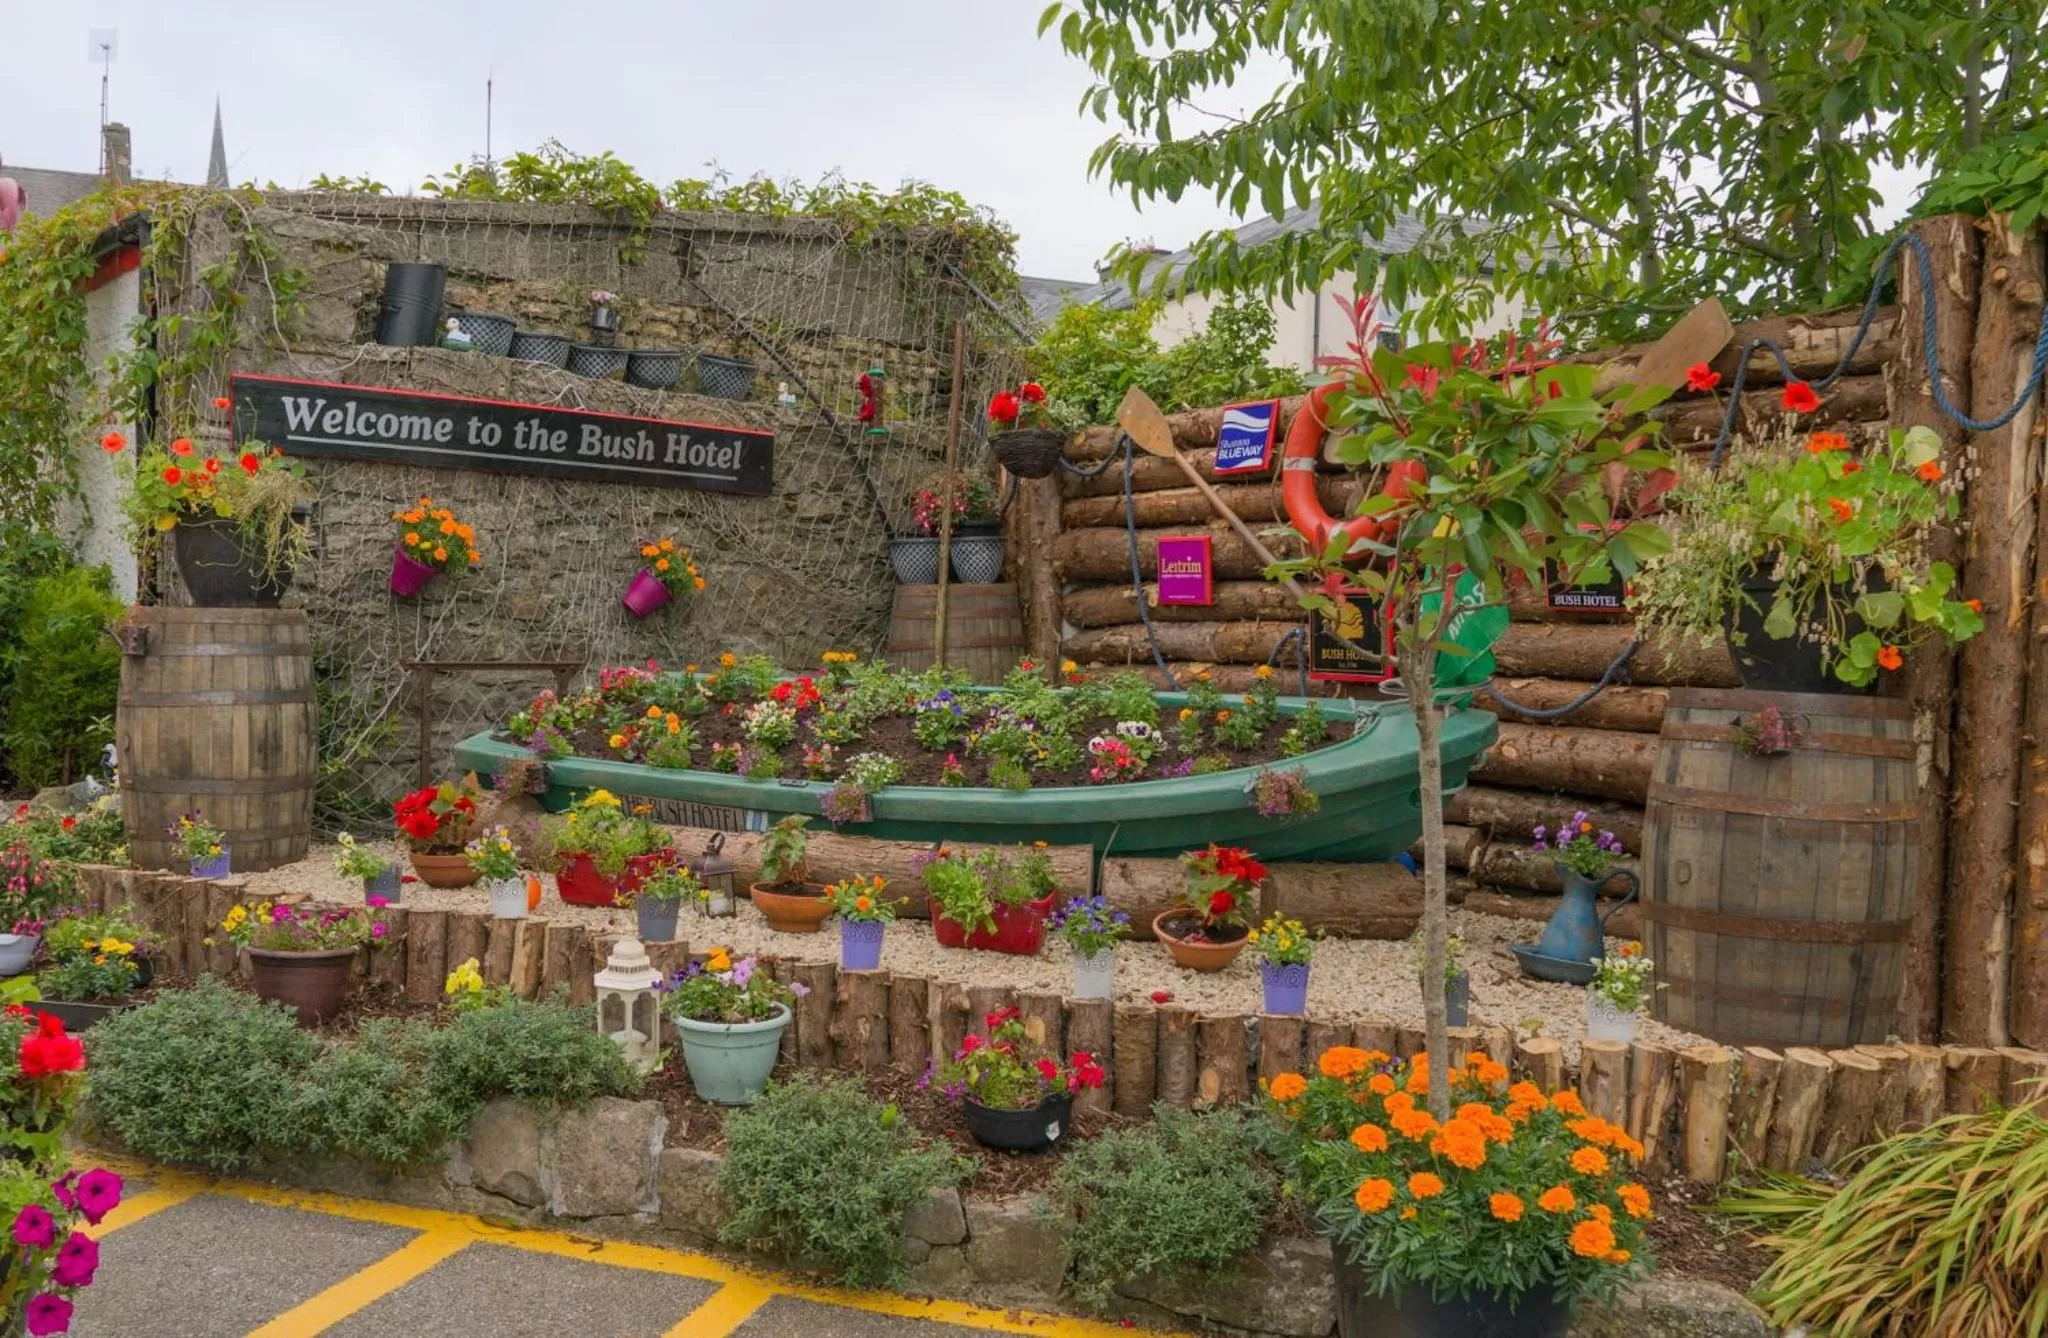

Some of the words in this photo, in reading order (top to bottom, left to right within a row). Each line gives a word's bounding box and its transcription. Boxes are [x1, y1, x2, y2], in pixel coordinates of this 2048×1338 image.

[281, 396, 454, 442] Welcome
[467, 415, 502, 447] to
[513, 418, 568, 453] the
[577, 423, 655, 461] Bush
[663, 433, 742, 470] Hotel
[1218, 444, 1264, 460] BLUEWAY
[1161, 556, 1202, 573] Leitrim
[1553, 594, 1582, 606] BUSH
[1582, 595, 1620, 607] HOTEL
